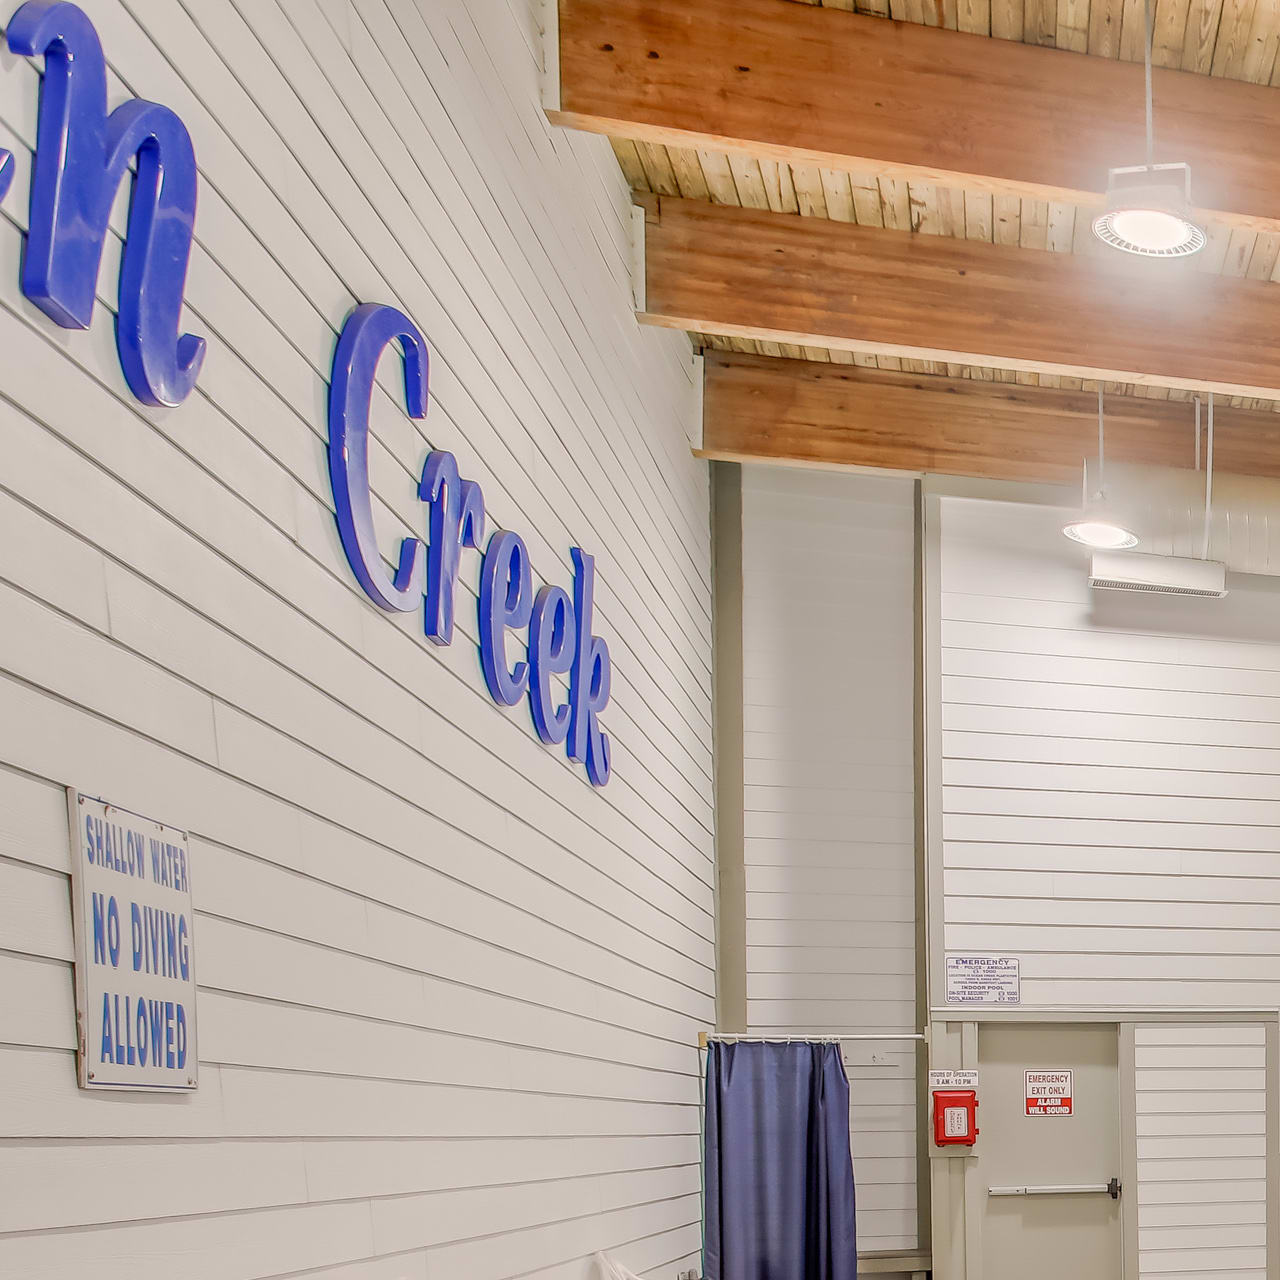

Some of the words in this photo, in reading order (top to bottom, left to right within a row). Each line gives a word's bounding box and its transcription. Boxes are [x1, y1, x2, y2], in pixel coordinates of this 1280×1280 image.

[328, 301, 611, 787] Creek
[86, 814, 145, 880] SHALLOW
[149, 837, 189, 894] WATER
[92, 891, 121, 968] NO
[131, 901, 190, 982] DIVING
[100, 992, 188, 1070] ALLOWED
[1028, 1074, 1069, 1083] EMERGENCY
[1031, 1086, 1046, 1095] EXIT
[1049, 1086, 1066, 1095] ONLY
[1036, 1098, 1062, 1106] ALARM
